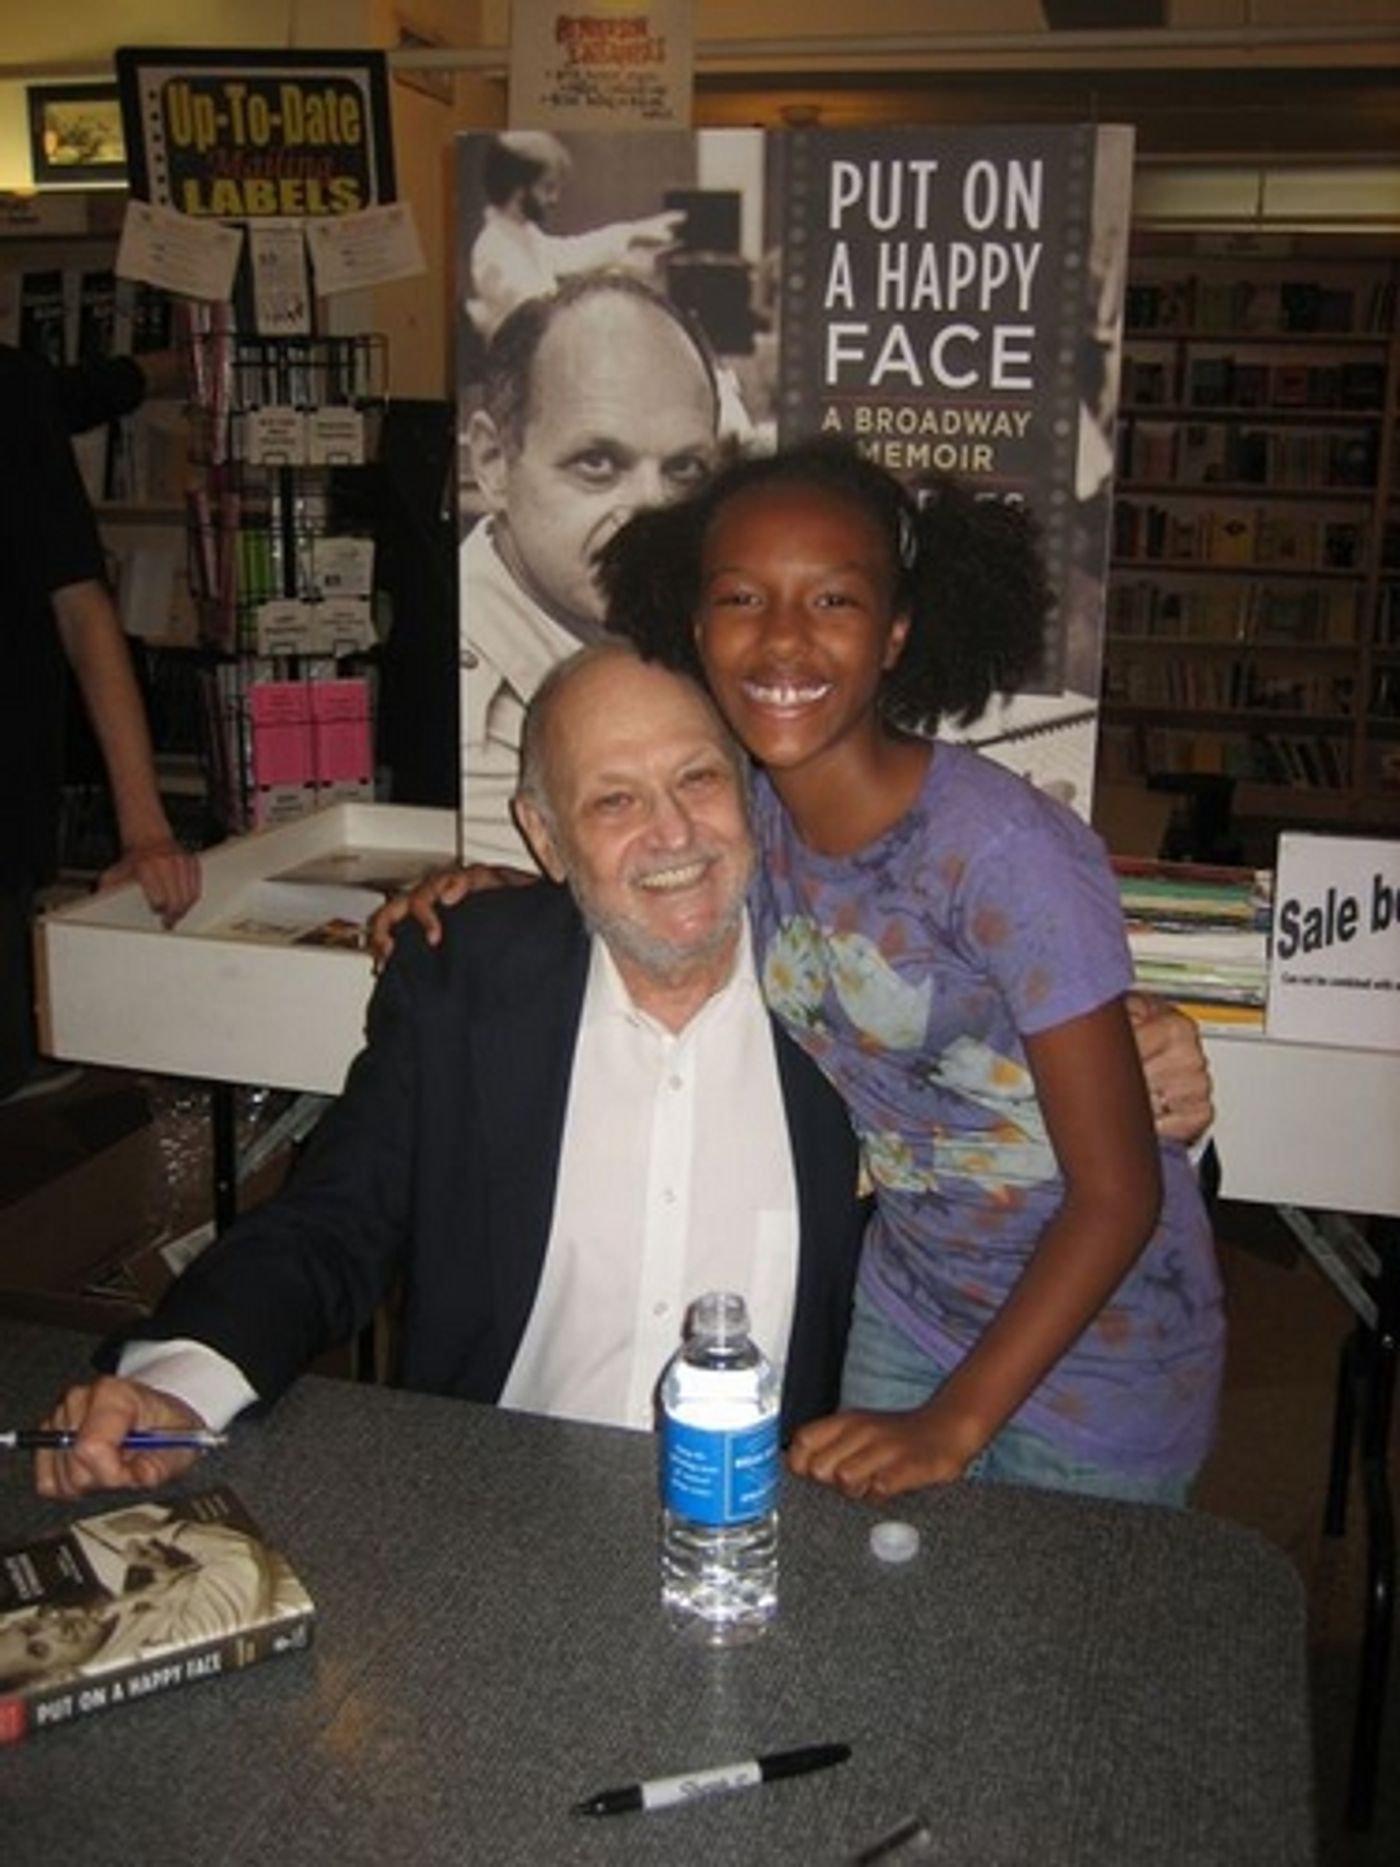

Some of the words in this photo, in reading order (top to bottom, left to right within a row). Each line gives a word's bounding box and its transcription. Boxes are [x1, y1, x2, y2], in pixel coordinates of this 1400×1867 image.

[167, 82, 361, 153] Up-To-Date
[182, 175, 361, 216] LABELS
[828, 160, 939, 231] PUT
[961, 159, 1044, 231] ON
[824, 241, 855, 310] A
[876, 241, 1044, 312] HAPPY
[825, 323, 1036, 390] FACE
[821, 405, 843, 432] A
[854, 406, 1033, 438] BROADWAY
[856, 440, 995, 472] MEMOIR
[1277, 886, 1358, 960] Sale
[1370, 872, 1400, 934] b
[37, 1694, 73, 1726] PUT
[79, 1686, 107, 1712] ON
[111, 1681, 125, 1703] A
[127, 1664, 182, 1697] HAPPY
[186, 1651, 222, 1679] FACE
